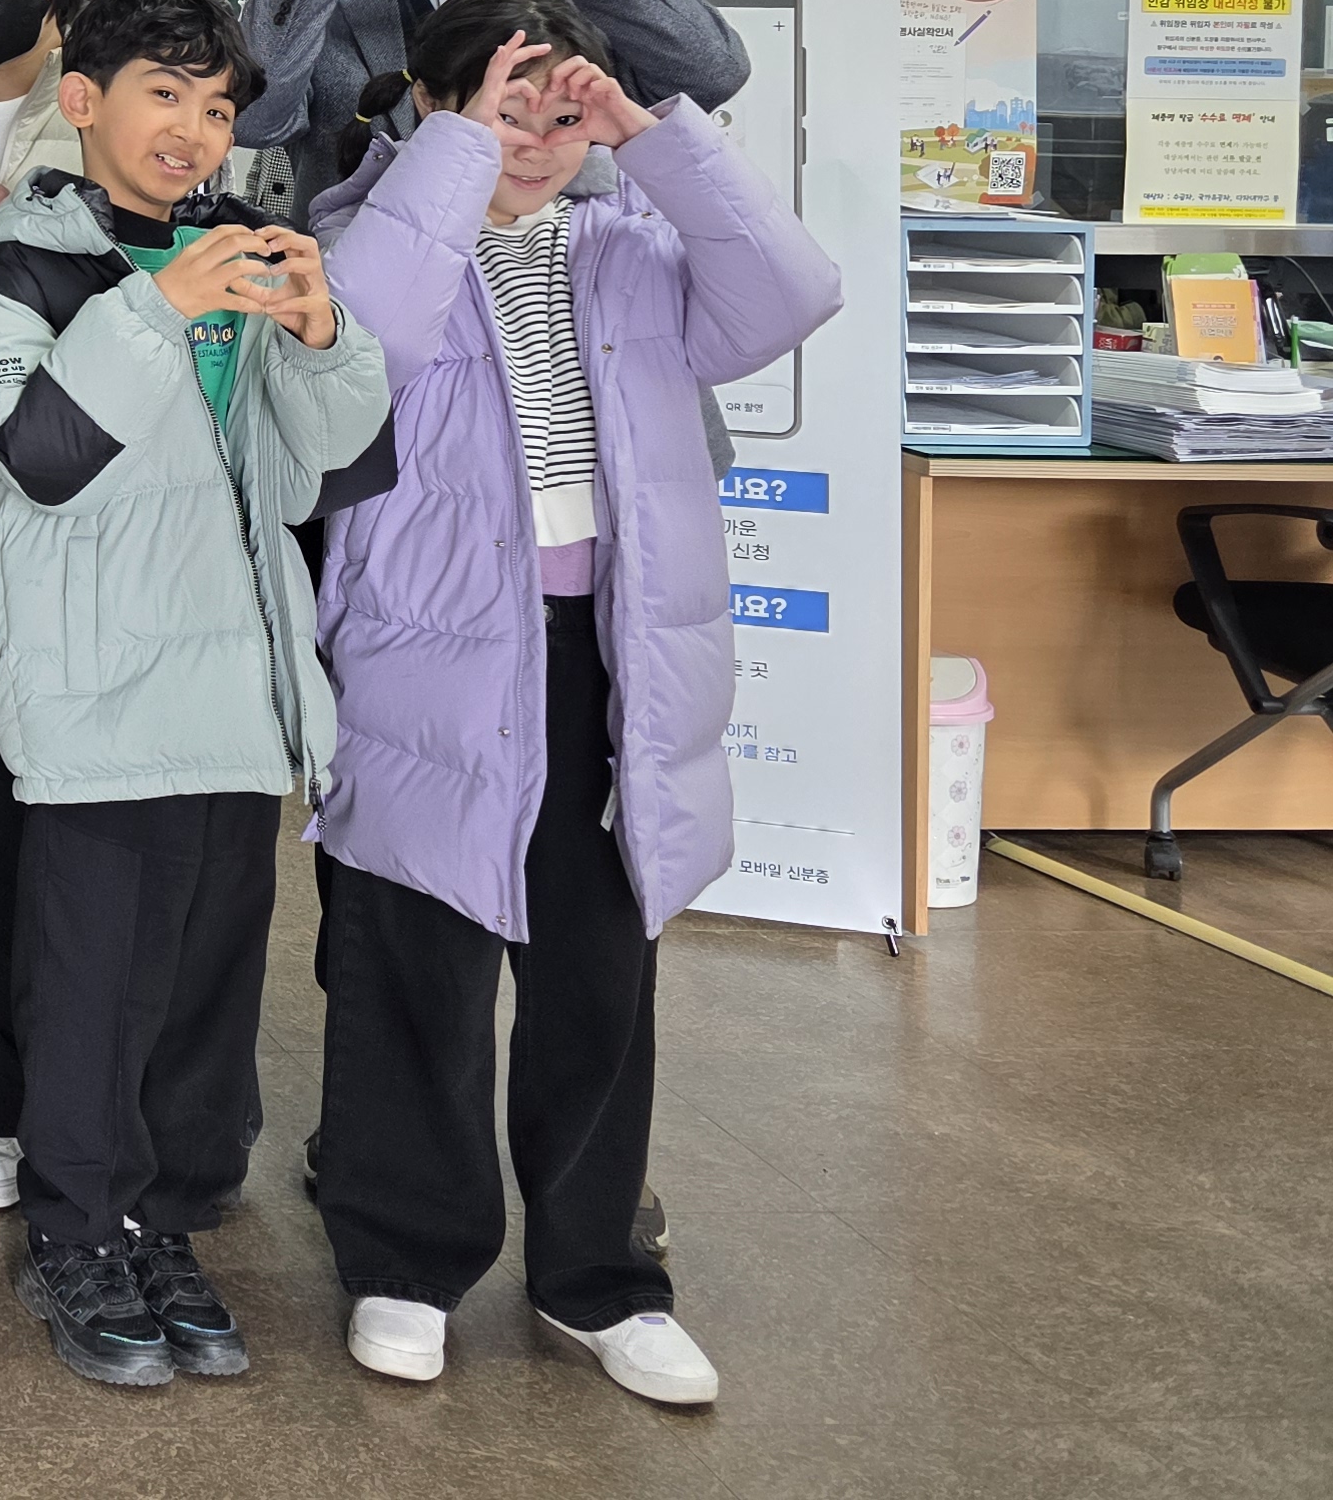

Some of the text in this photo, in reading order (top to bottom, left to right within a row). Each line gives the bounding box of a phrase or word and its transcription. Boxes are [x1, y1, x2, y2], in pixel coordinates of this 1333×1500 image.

[725, 403, 764, 413] QR 촬영
[732, 543, 770, 561] 신청
[750, 661, 769, 679] 곳
[764, 746, 798, 763] 참고
[739, 860, 829, 884] 모바일 신분증
